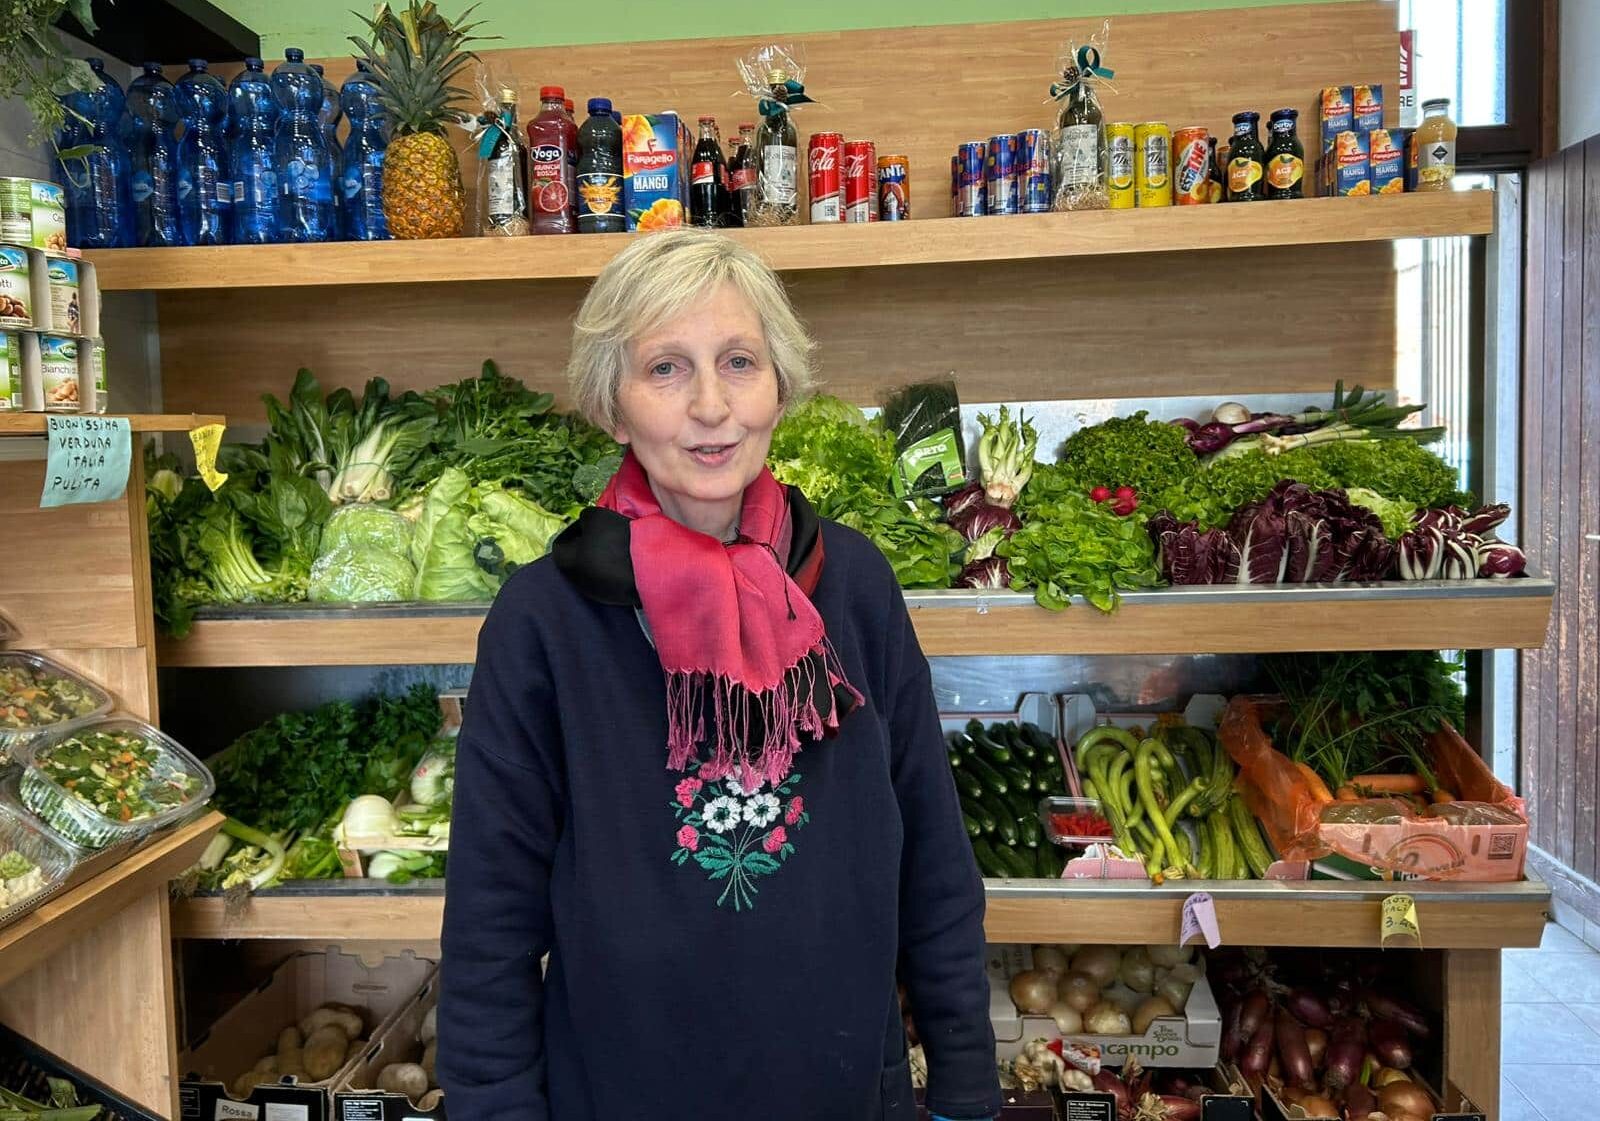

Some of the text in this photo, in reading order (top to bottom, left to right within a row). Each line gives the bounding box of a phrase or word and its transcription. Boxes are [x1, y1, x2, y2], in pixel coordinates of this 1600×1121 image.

[1273, 120, 1294, 130] Derby
[533, 147, 560, 160] Yoga
[633, 175, 669, 190] MANGO
[41, 363, 71, 373] Bianchi
[1100, 1043, 1179, 1060] campo
